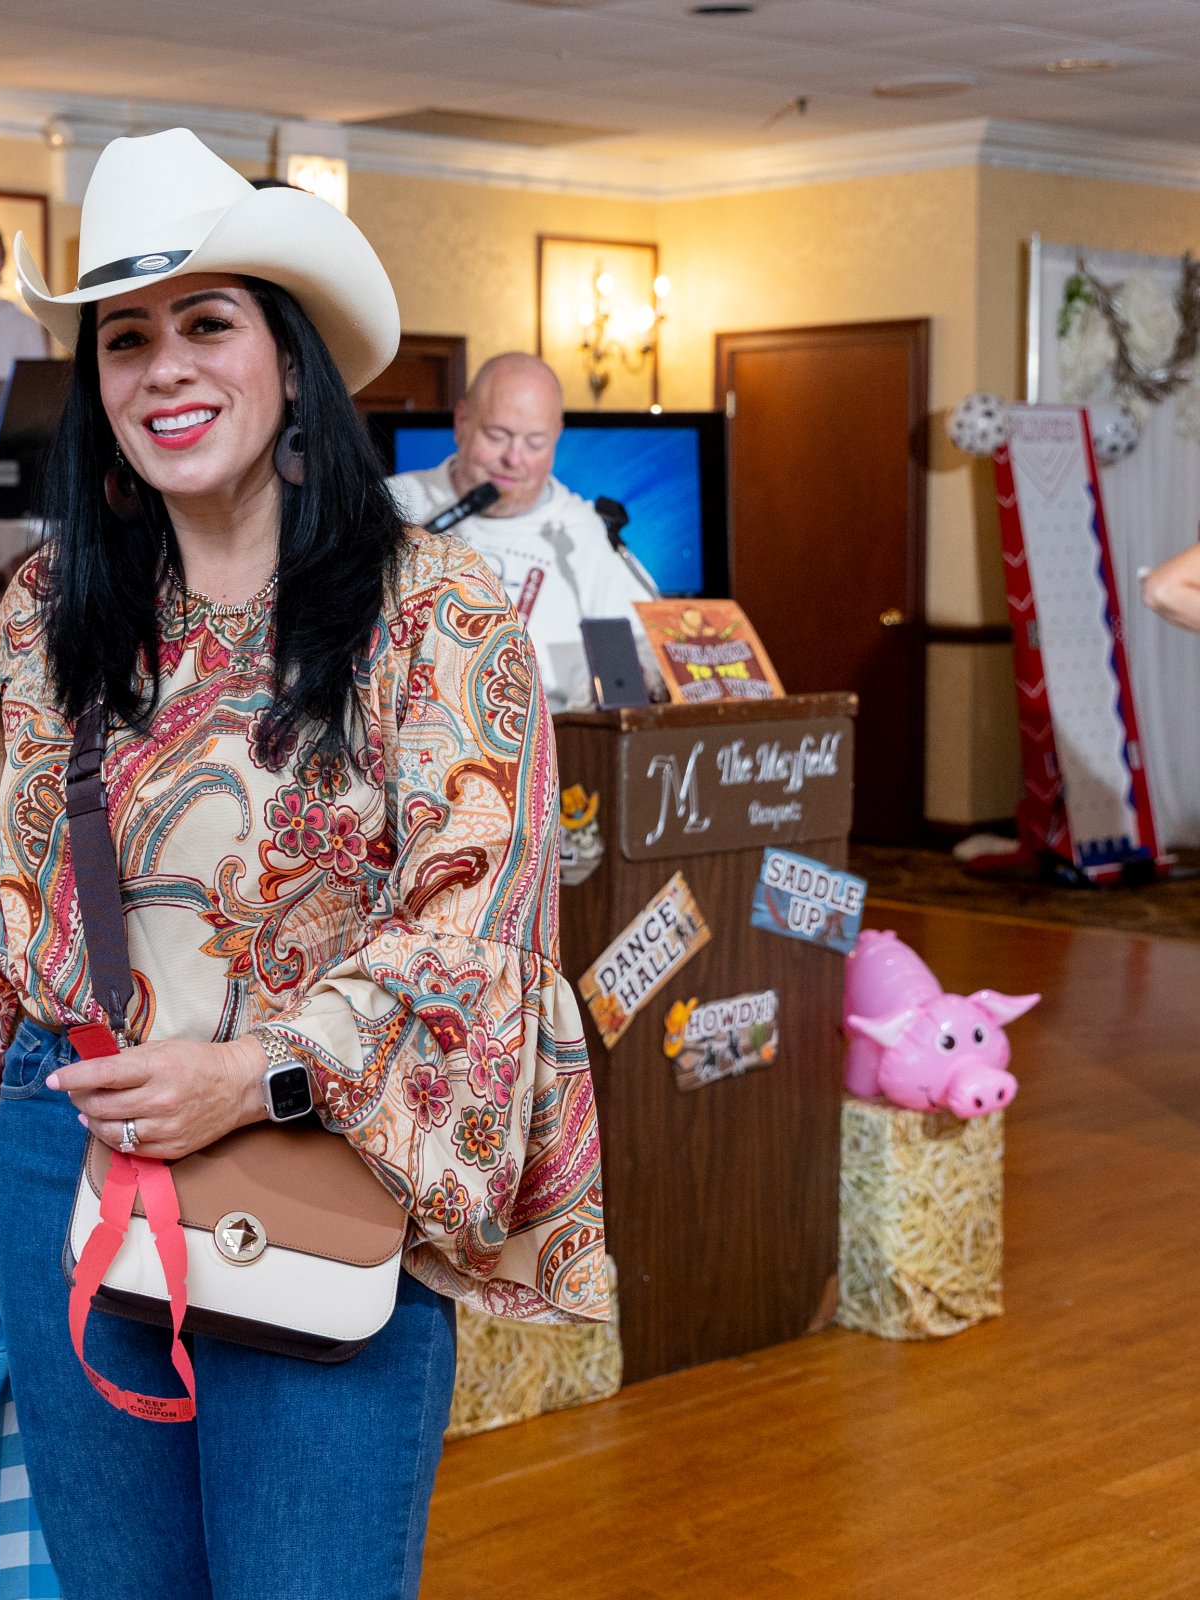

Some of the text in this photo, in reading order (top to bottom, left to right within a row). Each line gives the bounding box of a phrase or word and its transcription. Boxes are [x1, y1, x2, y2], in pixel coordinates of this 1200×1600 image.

[717, 738, 753, 786] The
[766, 858, 859, 911] SADDLE
[791, 901, 821, 930] UP
[599, 901, 677, 992] DANCE
[620, 942, 681, 1009] HALL
[130, 1405, 177, 1418] COUPON
[137, 1397, 167, 1407] KEEP
